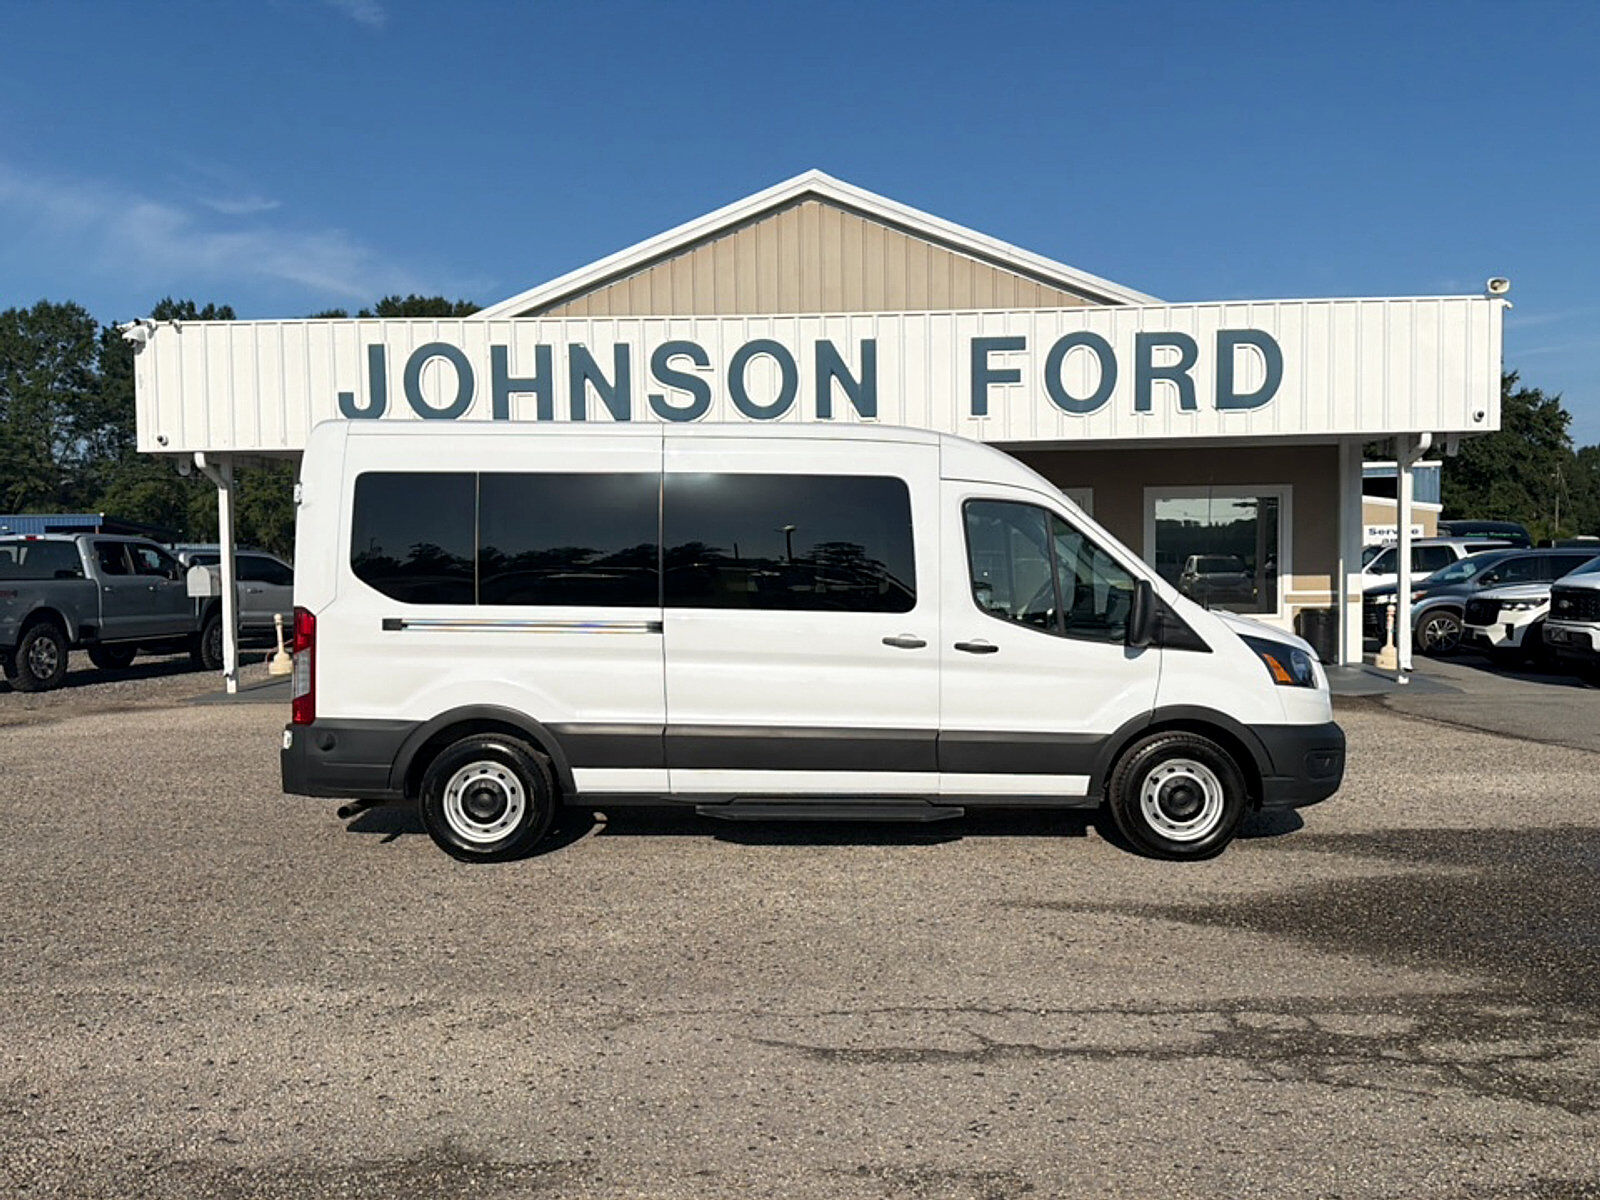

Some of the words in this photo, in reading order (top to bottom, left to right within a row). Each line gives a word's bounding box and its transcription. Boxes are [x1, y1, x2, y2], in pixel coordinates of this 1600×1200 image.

[338, 338, 877, 421] JOHNSON
[970, 329, 1284, 415] FORD
[1368, 527, 1419, 535] Serve
